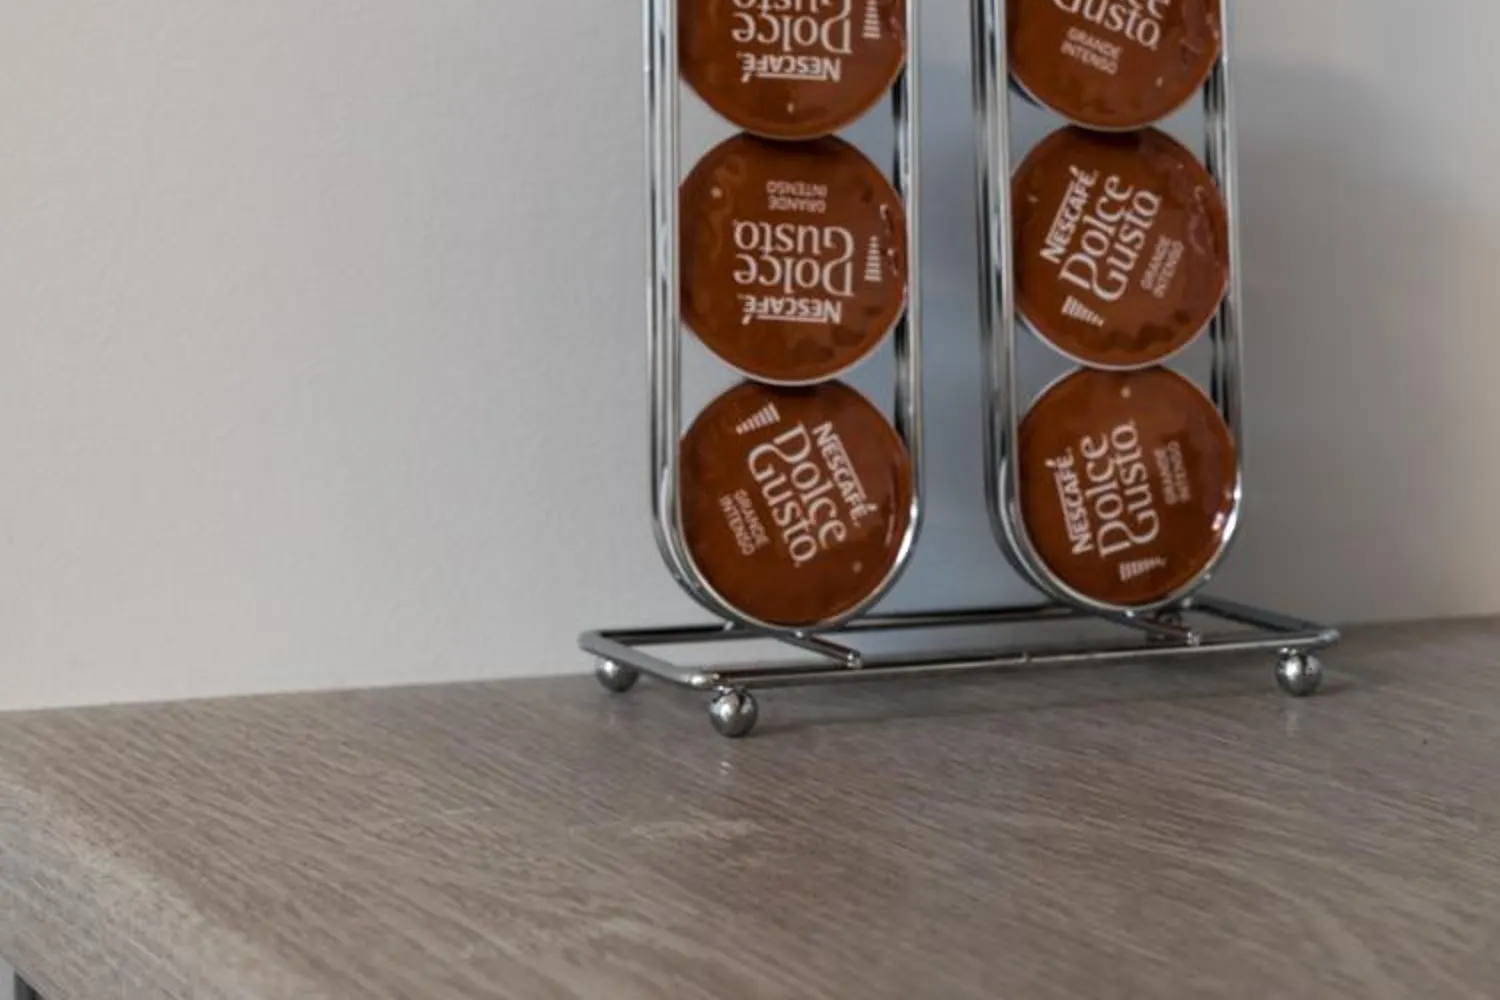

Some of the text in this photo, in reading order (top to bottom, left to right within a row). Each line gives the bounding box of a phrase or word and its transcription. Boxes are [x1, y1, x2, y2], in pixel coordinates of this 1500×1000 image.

[732, 12, 852, 54] Dolce
[1060, 40, 1118, 76] INTENSO
[1067, 27, 1121, 59] GRANDE
[766, 181, 827, 196] INTENSO
[768, 196, 826, 213] GRANDE
[733, 220, 854, 261] Gusto
[1059, 175, 1134, 289] Dolce
[1093, 190, 1160, 301] Gusto
[733, 254, 854, 297] Dolce
[748, 444, 818, 562] Gusto
[774, 422, 847, 548] Dolce
[1080, 433, 1131, 557] Dolce
[1112, 423, 1159, 544] Gusto
[720, 495, 755, 555] INTENSO
[733, 489, 770, 548] GRANDE
